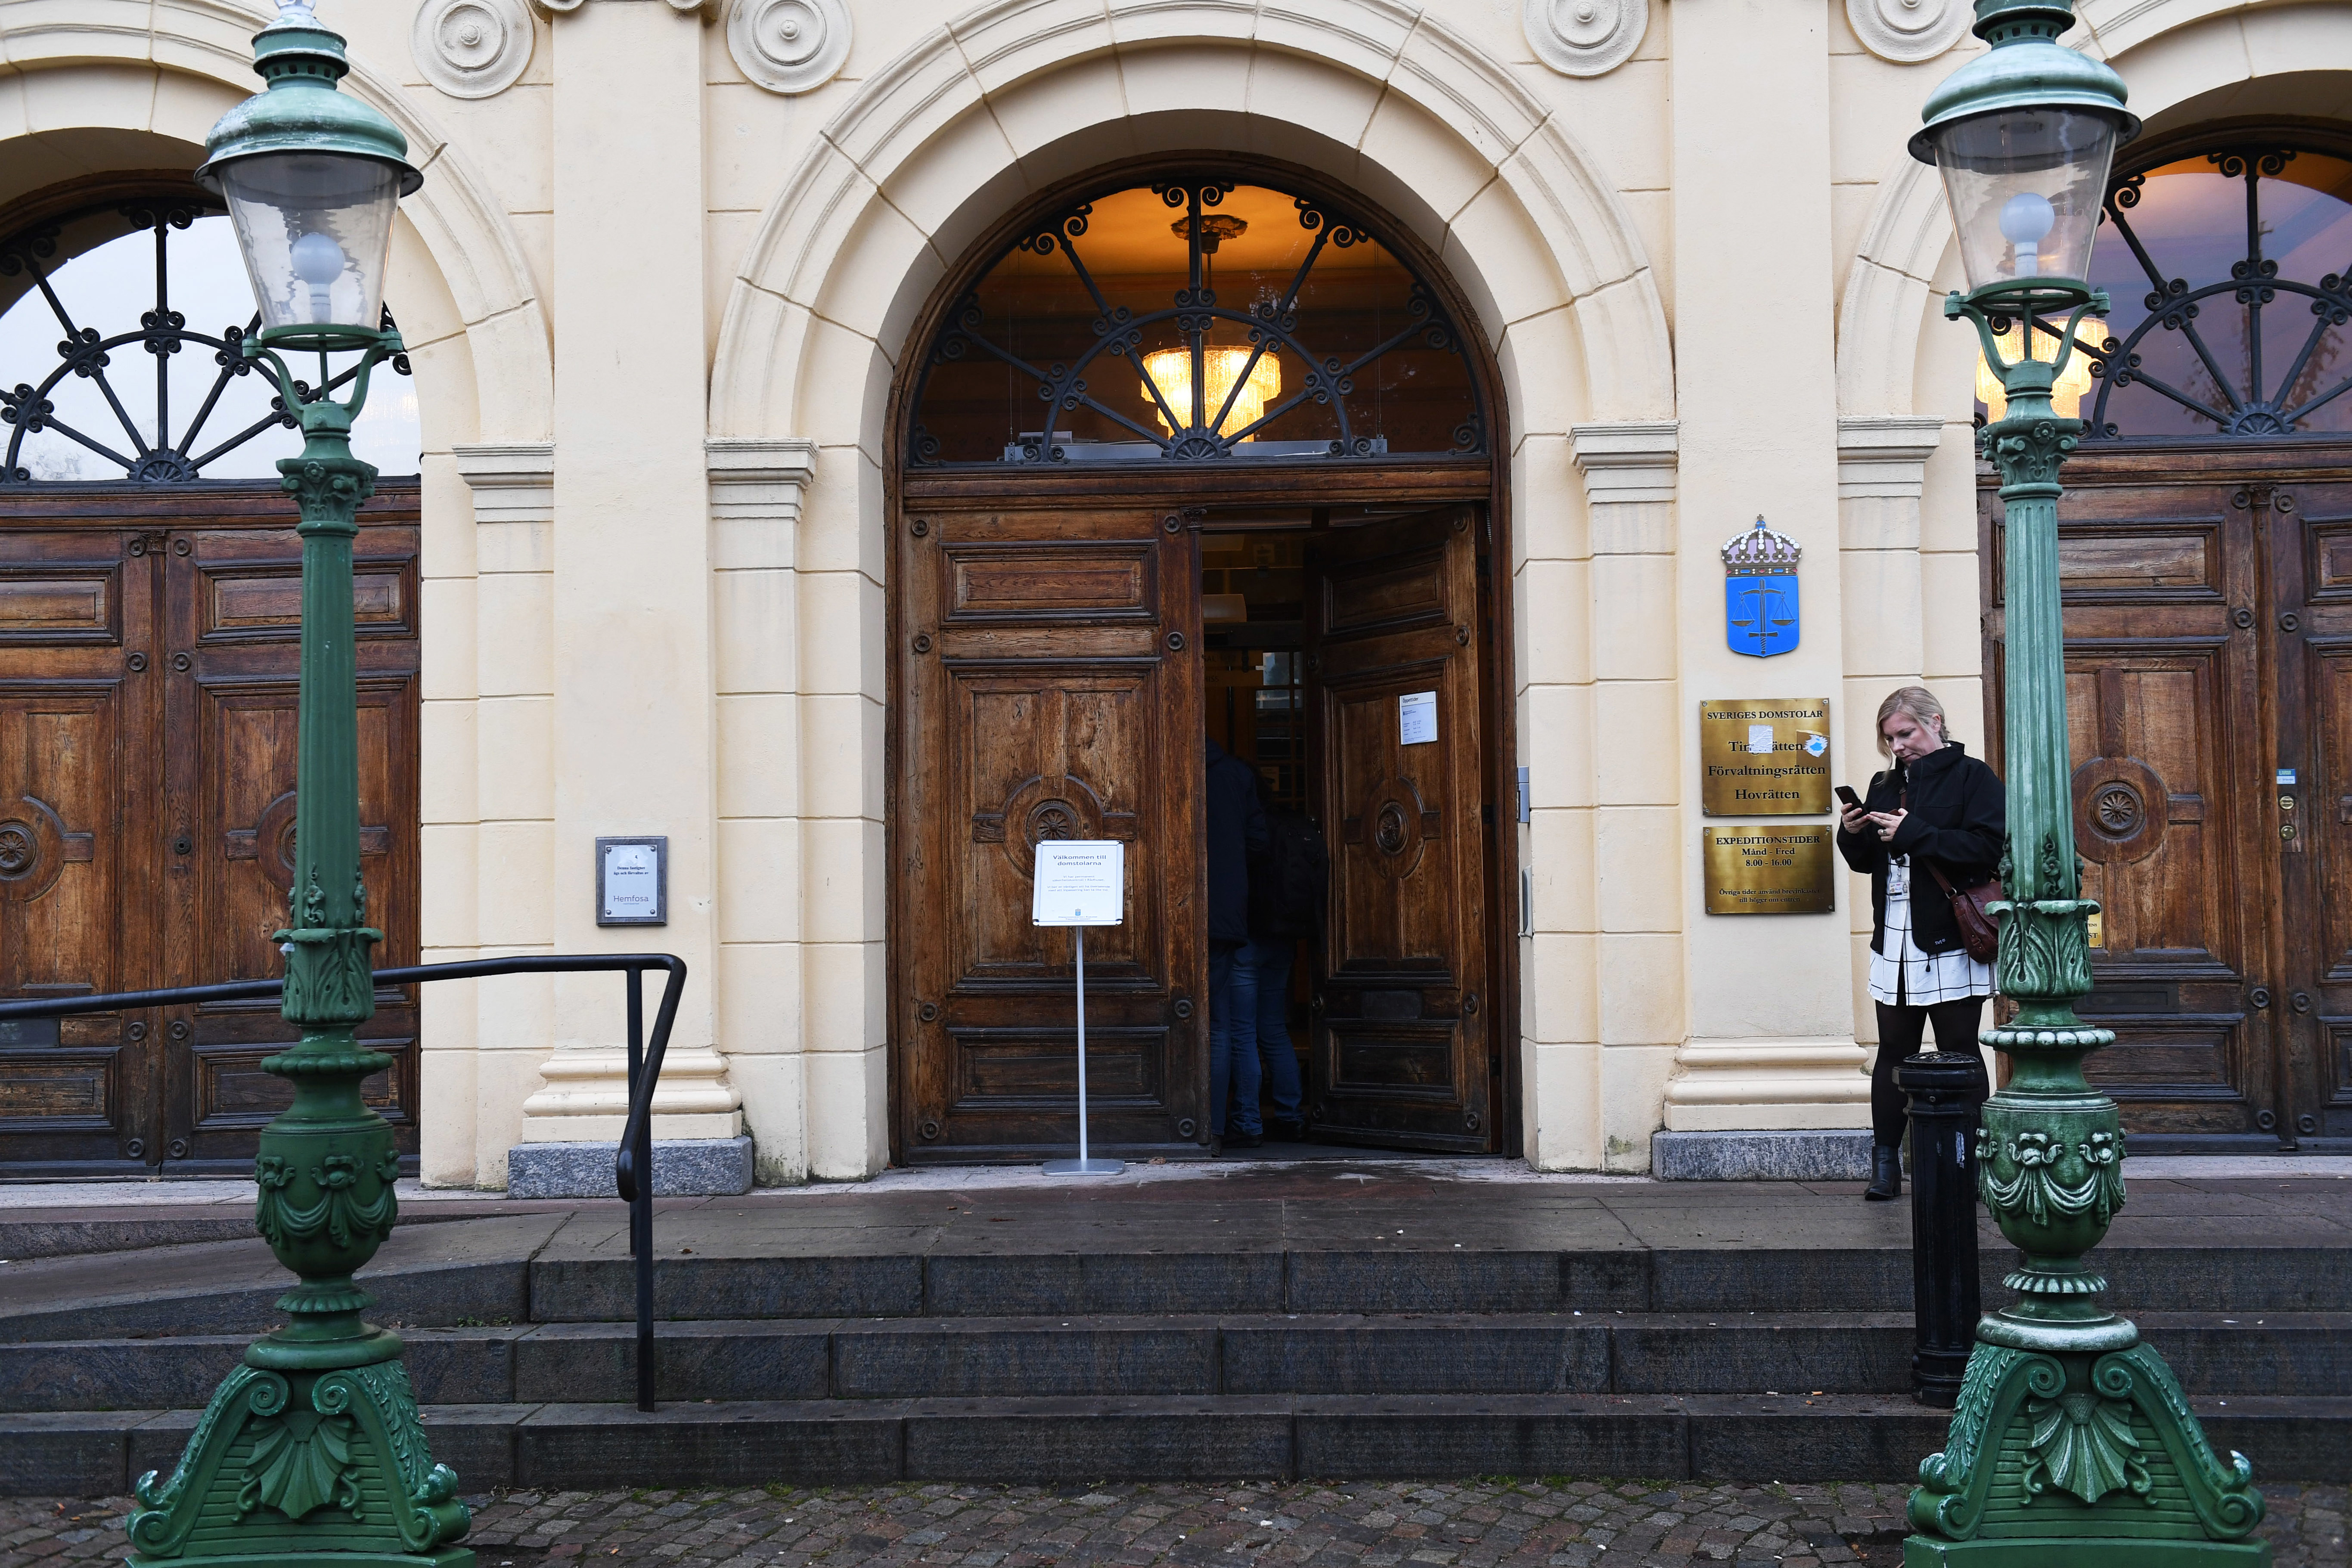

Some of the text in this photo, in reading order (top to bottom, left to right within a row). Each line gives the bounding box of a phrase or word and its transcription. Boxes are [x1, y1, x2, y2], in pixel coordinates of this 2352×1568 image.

[1707, 710, 1824, 719] SVERIGES DOMSTOLAR
[1708, 765, 1826, 779] Förvaltningsrätten
[1735, 789, 1800, 800] Hovrätten
[1716, 835, 1821, 845] EXPEDITIONSTIDER
[1741, 848, 1767, 856] Månd
[1775, 847, 1795, 855] Fred
